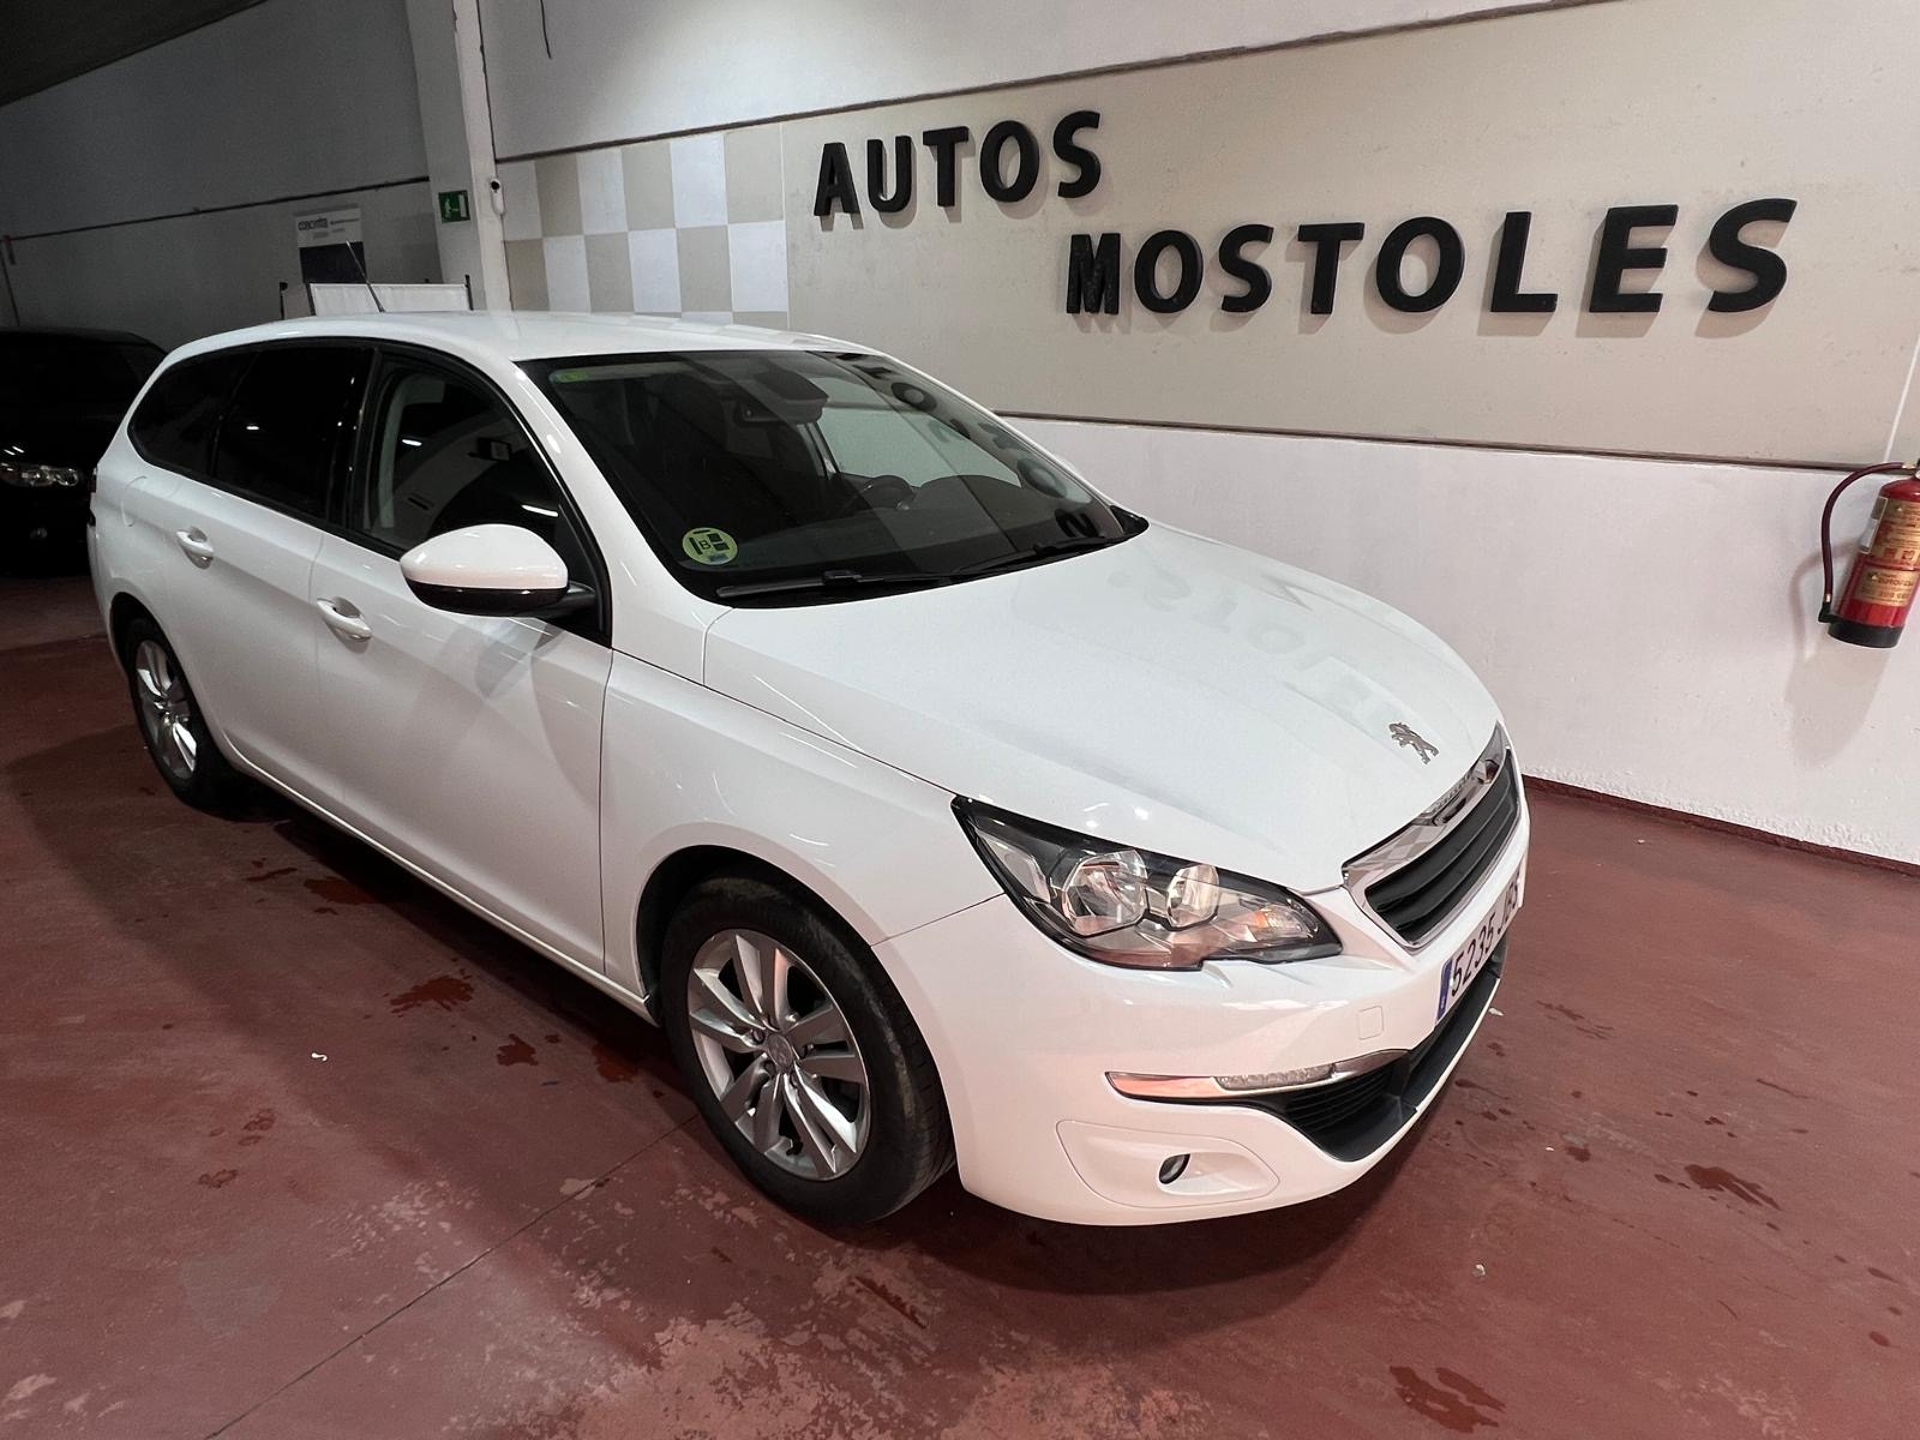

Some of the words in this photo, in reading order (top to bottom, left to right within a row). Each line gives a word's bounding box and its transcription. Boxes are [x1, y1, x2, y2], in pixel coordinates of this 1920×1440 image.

[813, 110, 1101, 217] AUTOS
[1066, 198, 1798, 314] MOSTOLES
[698, 540, 712, 550] B
[1451, 911, 1496, 997] 5235
